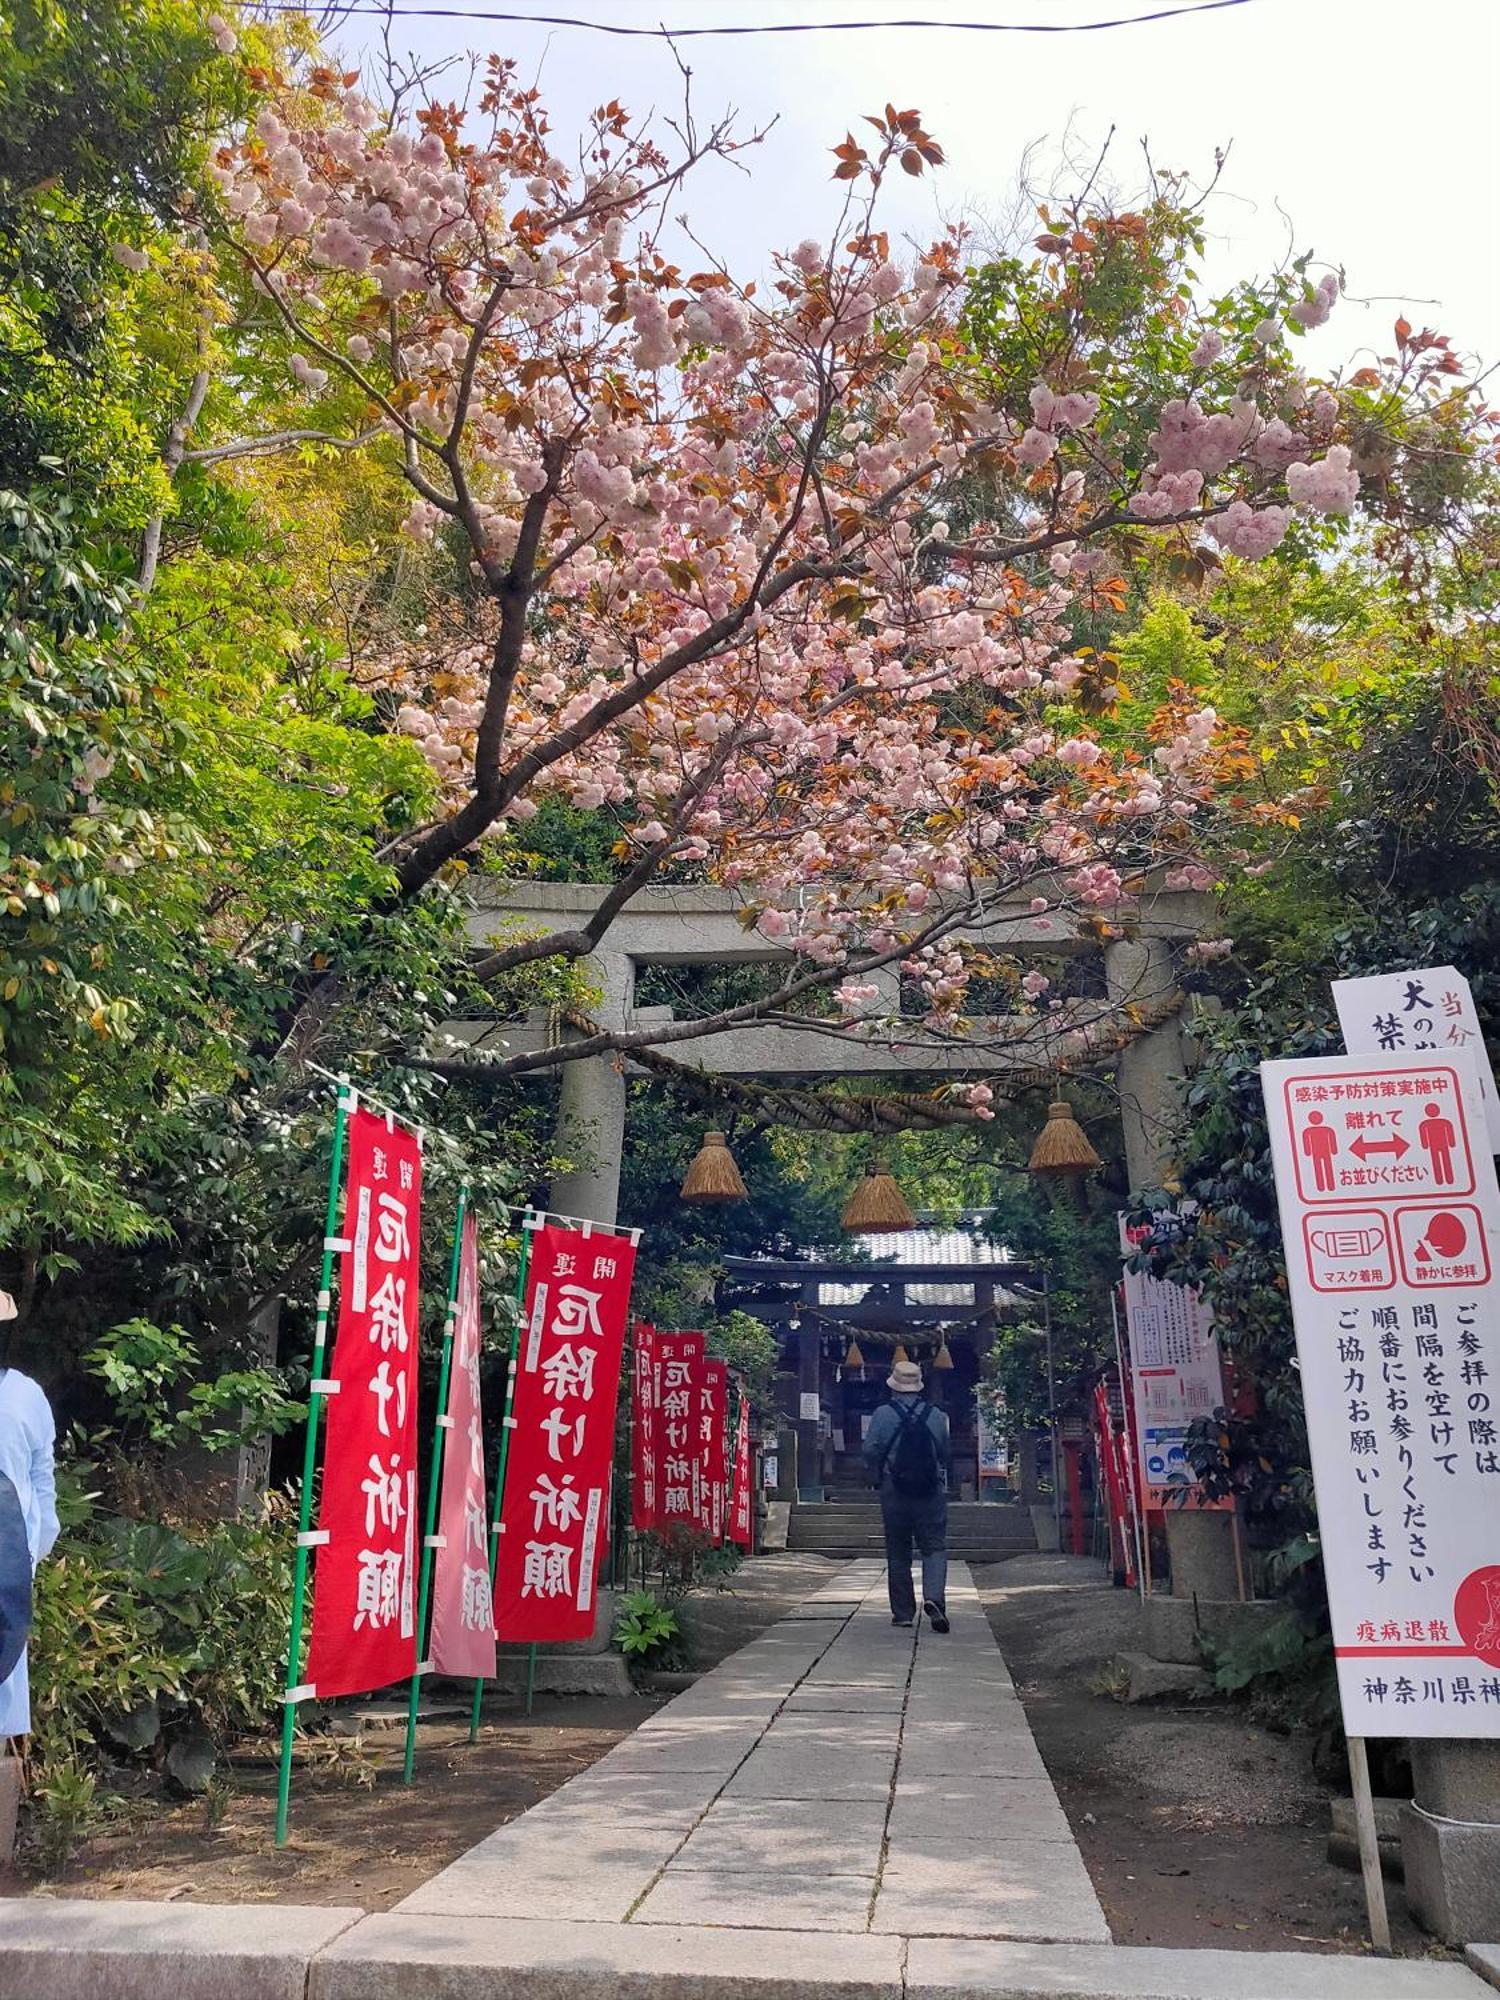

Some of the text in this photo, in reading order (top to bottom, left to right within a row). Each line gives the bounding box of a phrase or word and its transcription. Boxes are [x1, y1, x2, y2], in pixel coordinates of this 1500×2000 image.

[1403, 980, 1438, 1050] 犬の
[1295, 1077, 1448, 1102] 感染予防対策実施中
[1345, 1110, 1403, 1130] 離れて
[1339, 1165, 1429, 1186] お並びください
[1324, 1268, 1384, 1283] マスク着用
[1415, 1264, 1478, 1280] 静かに参拝
[1411, 1303, 1458, 1475] 間隔を空けて
[1456, 1302, 1500, 1474] ご参拝の際は
[1337, 1308, 1392, 1584] ご協力お願いします
[1372, 1306, 1434, 1582] 順番にお参りください
[1357, 1619, 1451, 1642] 疫病退散
